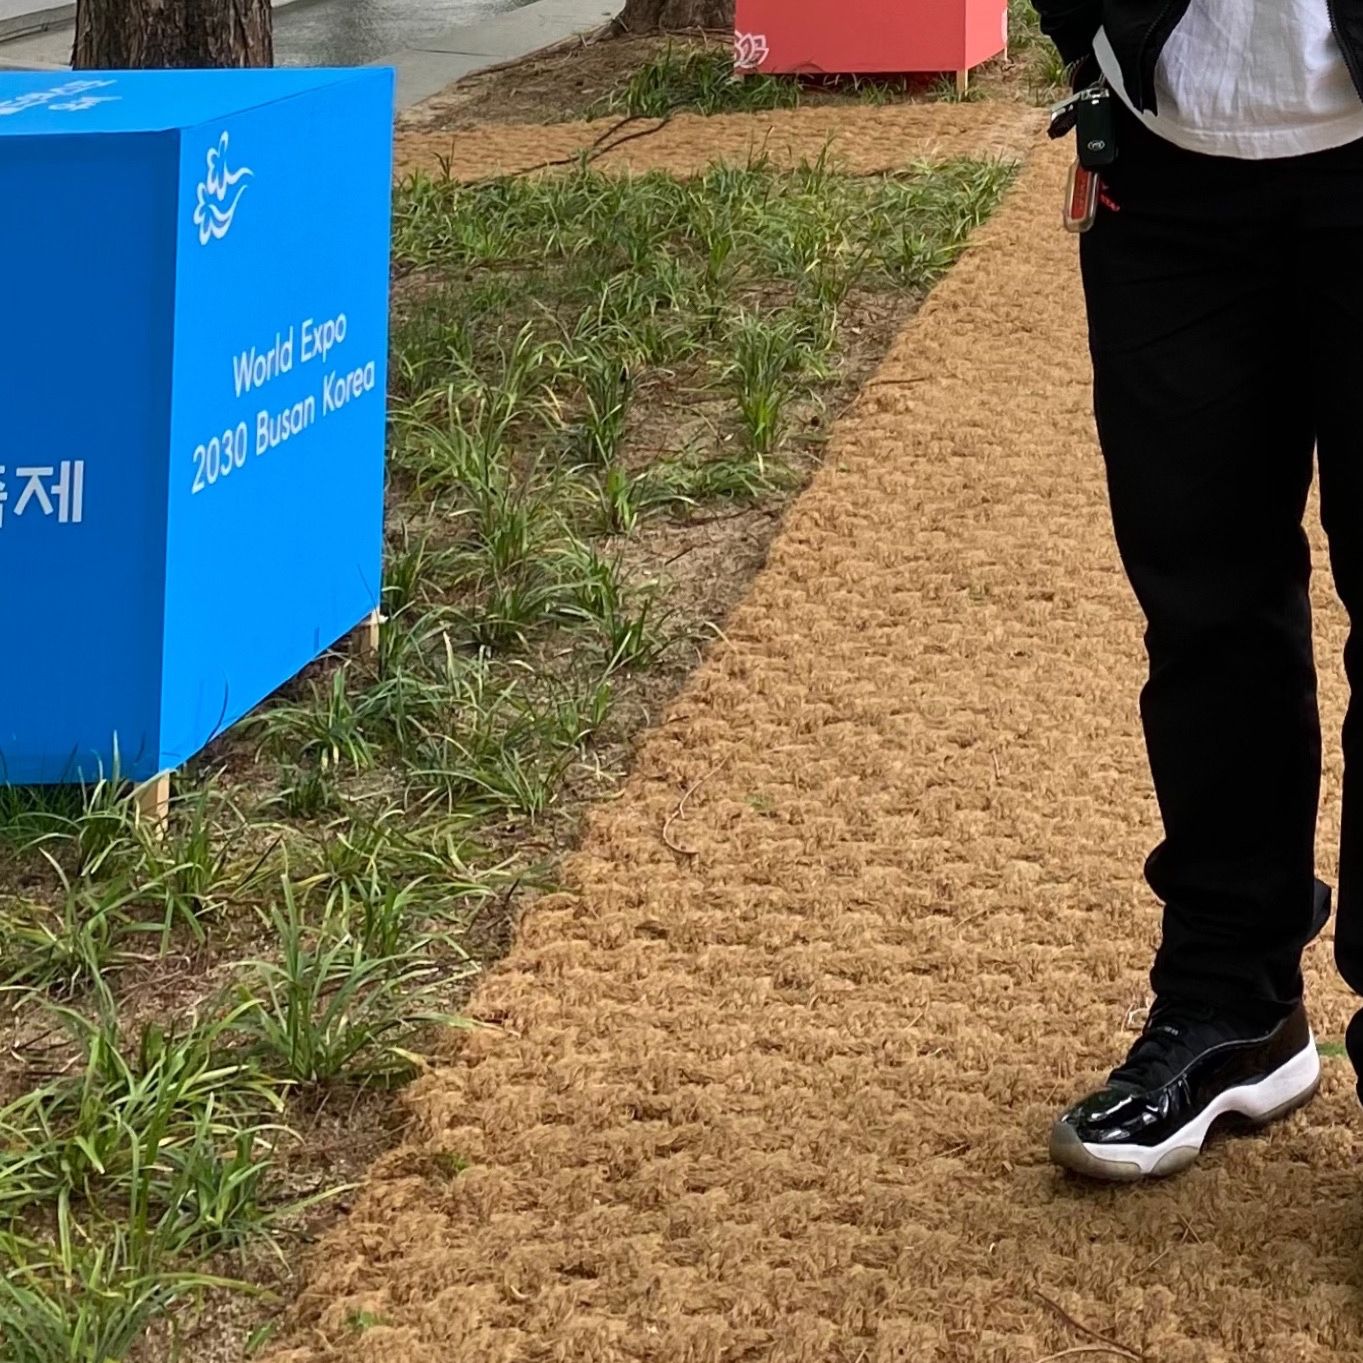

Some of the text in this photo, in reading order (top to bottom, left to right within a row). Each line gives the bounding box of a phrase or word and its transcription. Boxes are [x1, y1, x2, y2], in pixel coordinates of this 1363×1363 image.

[233, 313, 347, 398] World Expo
[191, 360, 376, 495] 2030 Busan Korea
[0, 460, 84, 528] 제
